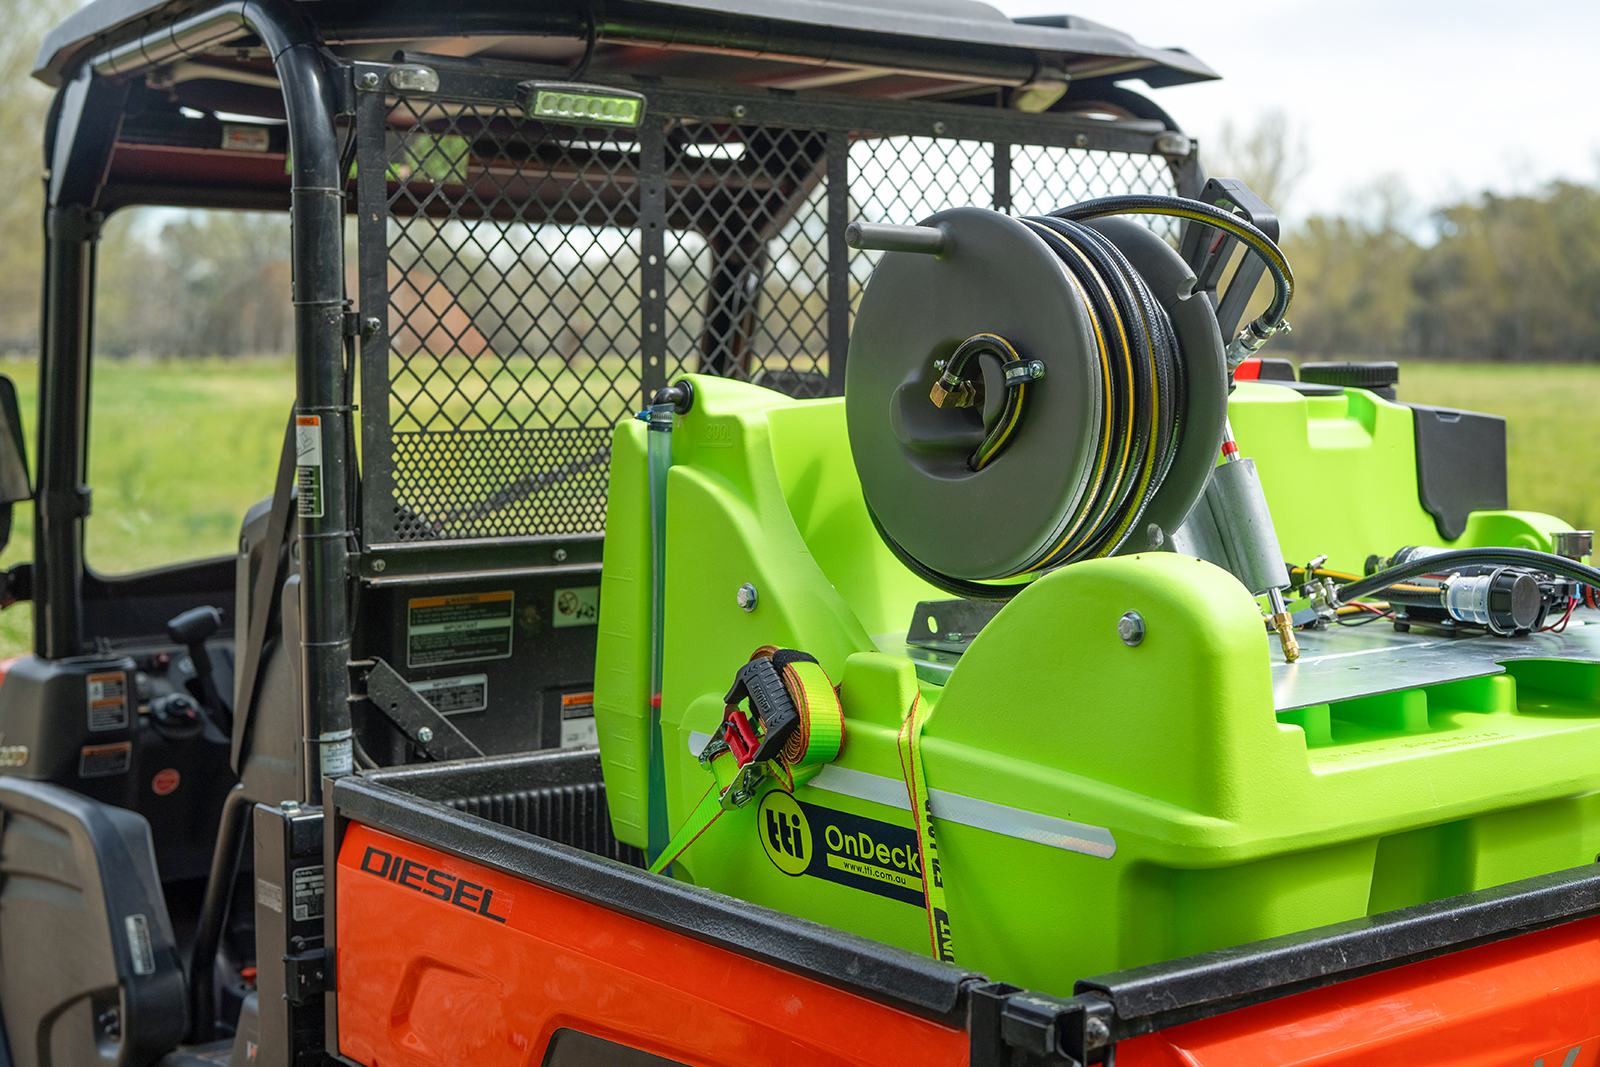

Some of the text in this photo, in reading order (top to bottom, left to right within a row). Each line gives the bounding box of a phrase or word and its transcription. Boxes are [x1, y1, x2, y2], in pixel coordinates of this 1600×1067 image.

[706, 423, 732, 440] 300L
[751, 683, 771, 713] GRUNT
[765, 808, 804, 859] tti
[825, 824, 921, 874] OnDeck
[360, 846, 507, 923] DIESEL
[843, 861, 906, 885] www.tti.com.au
